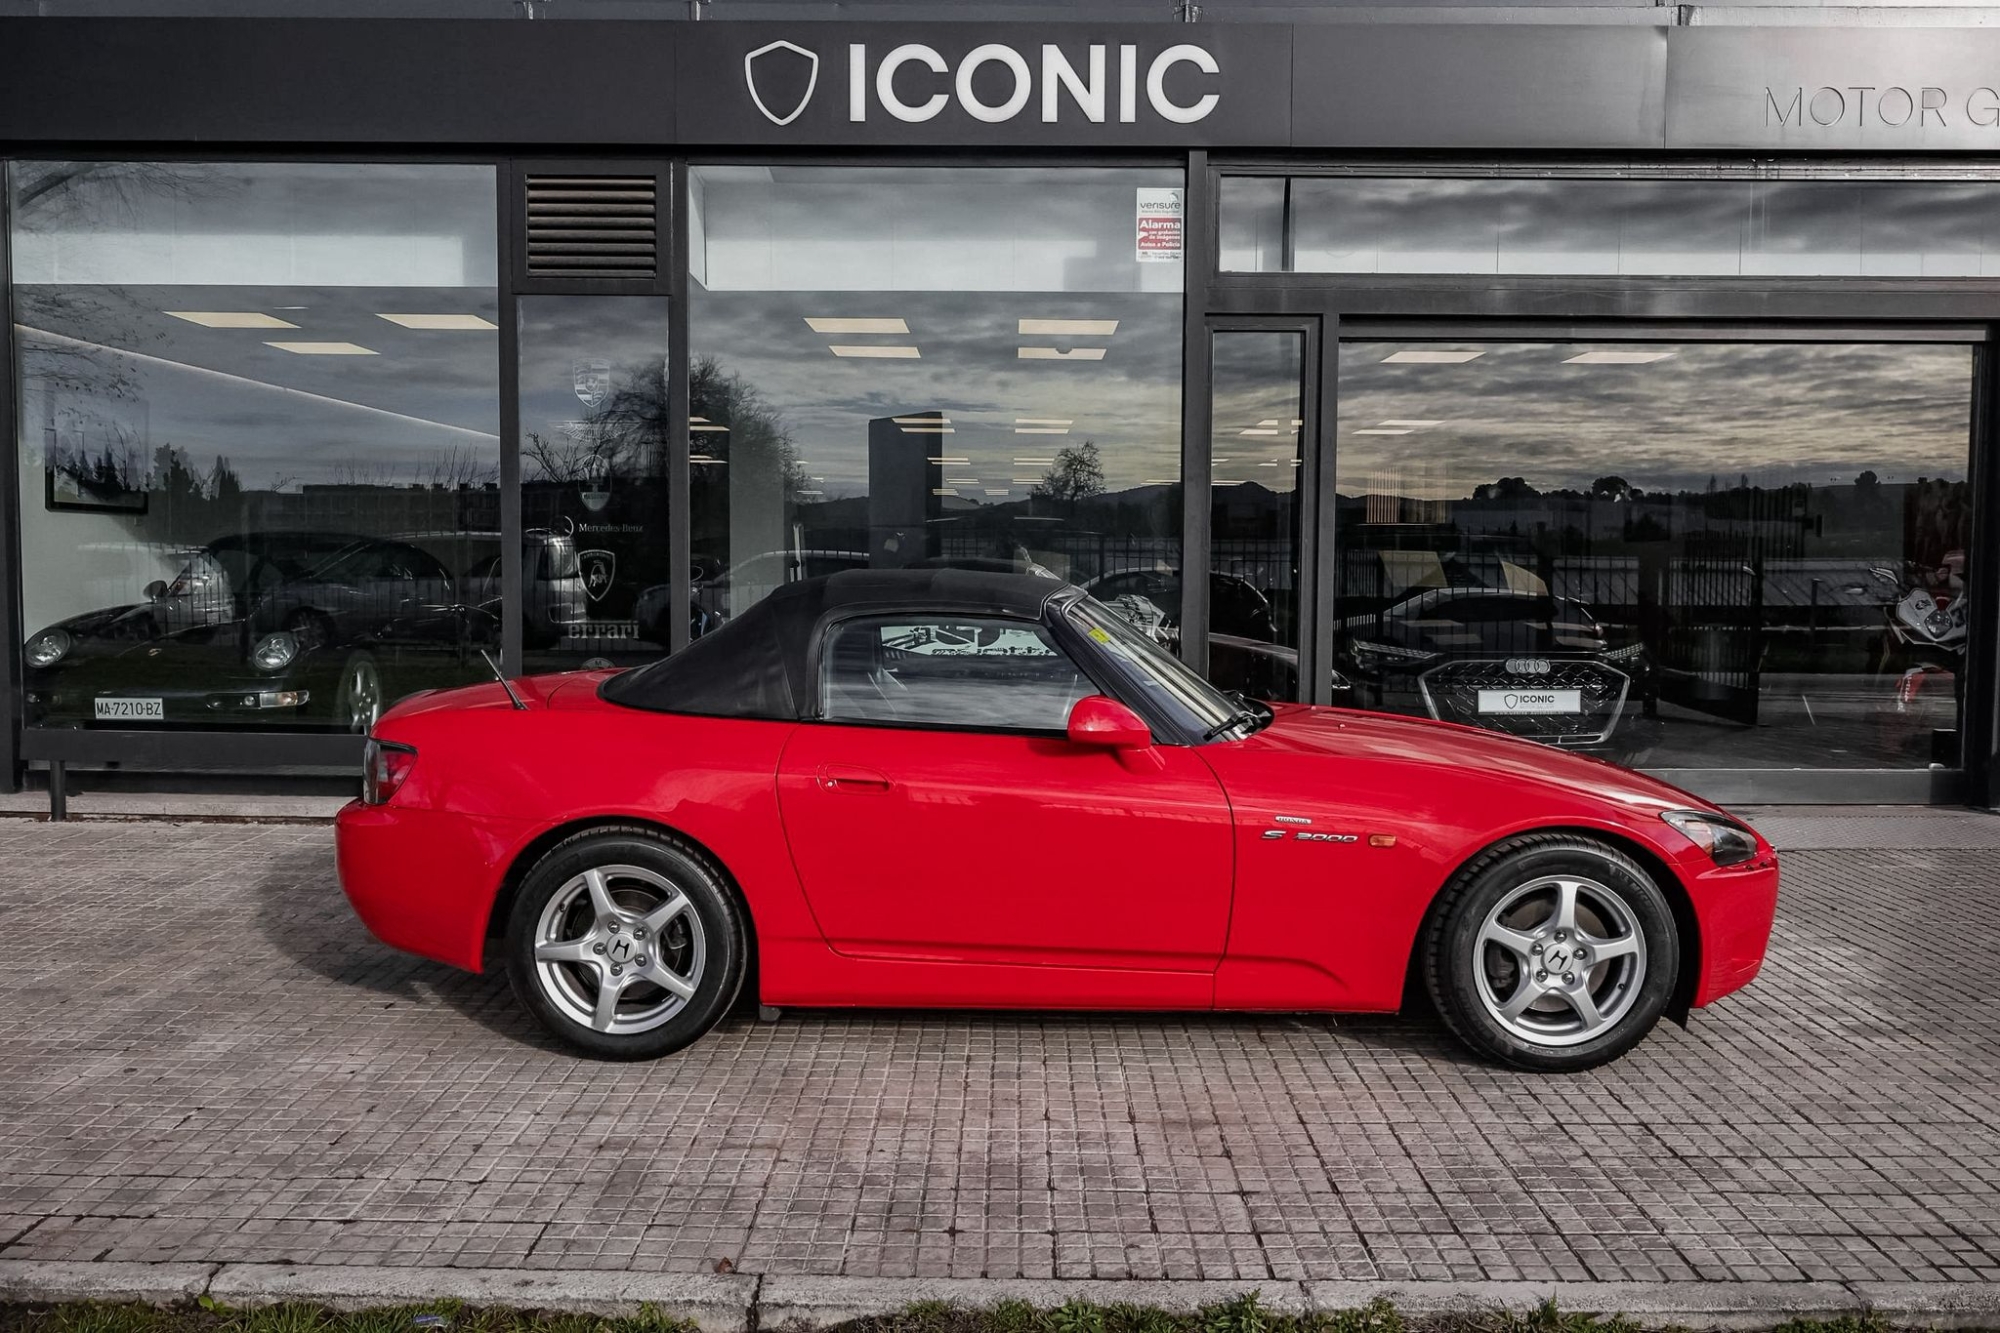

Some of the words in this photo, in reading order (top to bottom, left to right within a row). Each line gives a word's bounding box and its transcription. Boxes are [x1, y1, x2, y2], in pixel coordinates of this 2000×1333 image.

[849, 43, 1221, 124] ICONIC
[1765, 86, 1947, 127] MOTOR
[1140, 202, 1181, 210] verisure
[1140, 219, 1181, 229] Alarma
[578, 522, 644, 533] Mercedes-Benz
[1519, 695, 1555, 704] ICONIC
[96, 702, 162, 716] MA-7210-BZ
[1261, 830, 1287, 840] S
[1296, 832, 1359, 843] 2000
